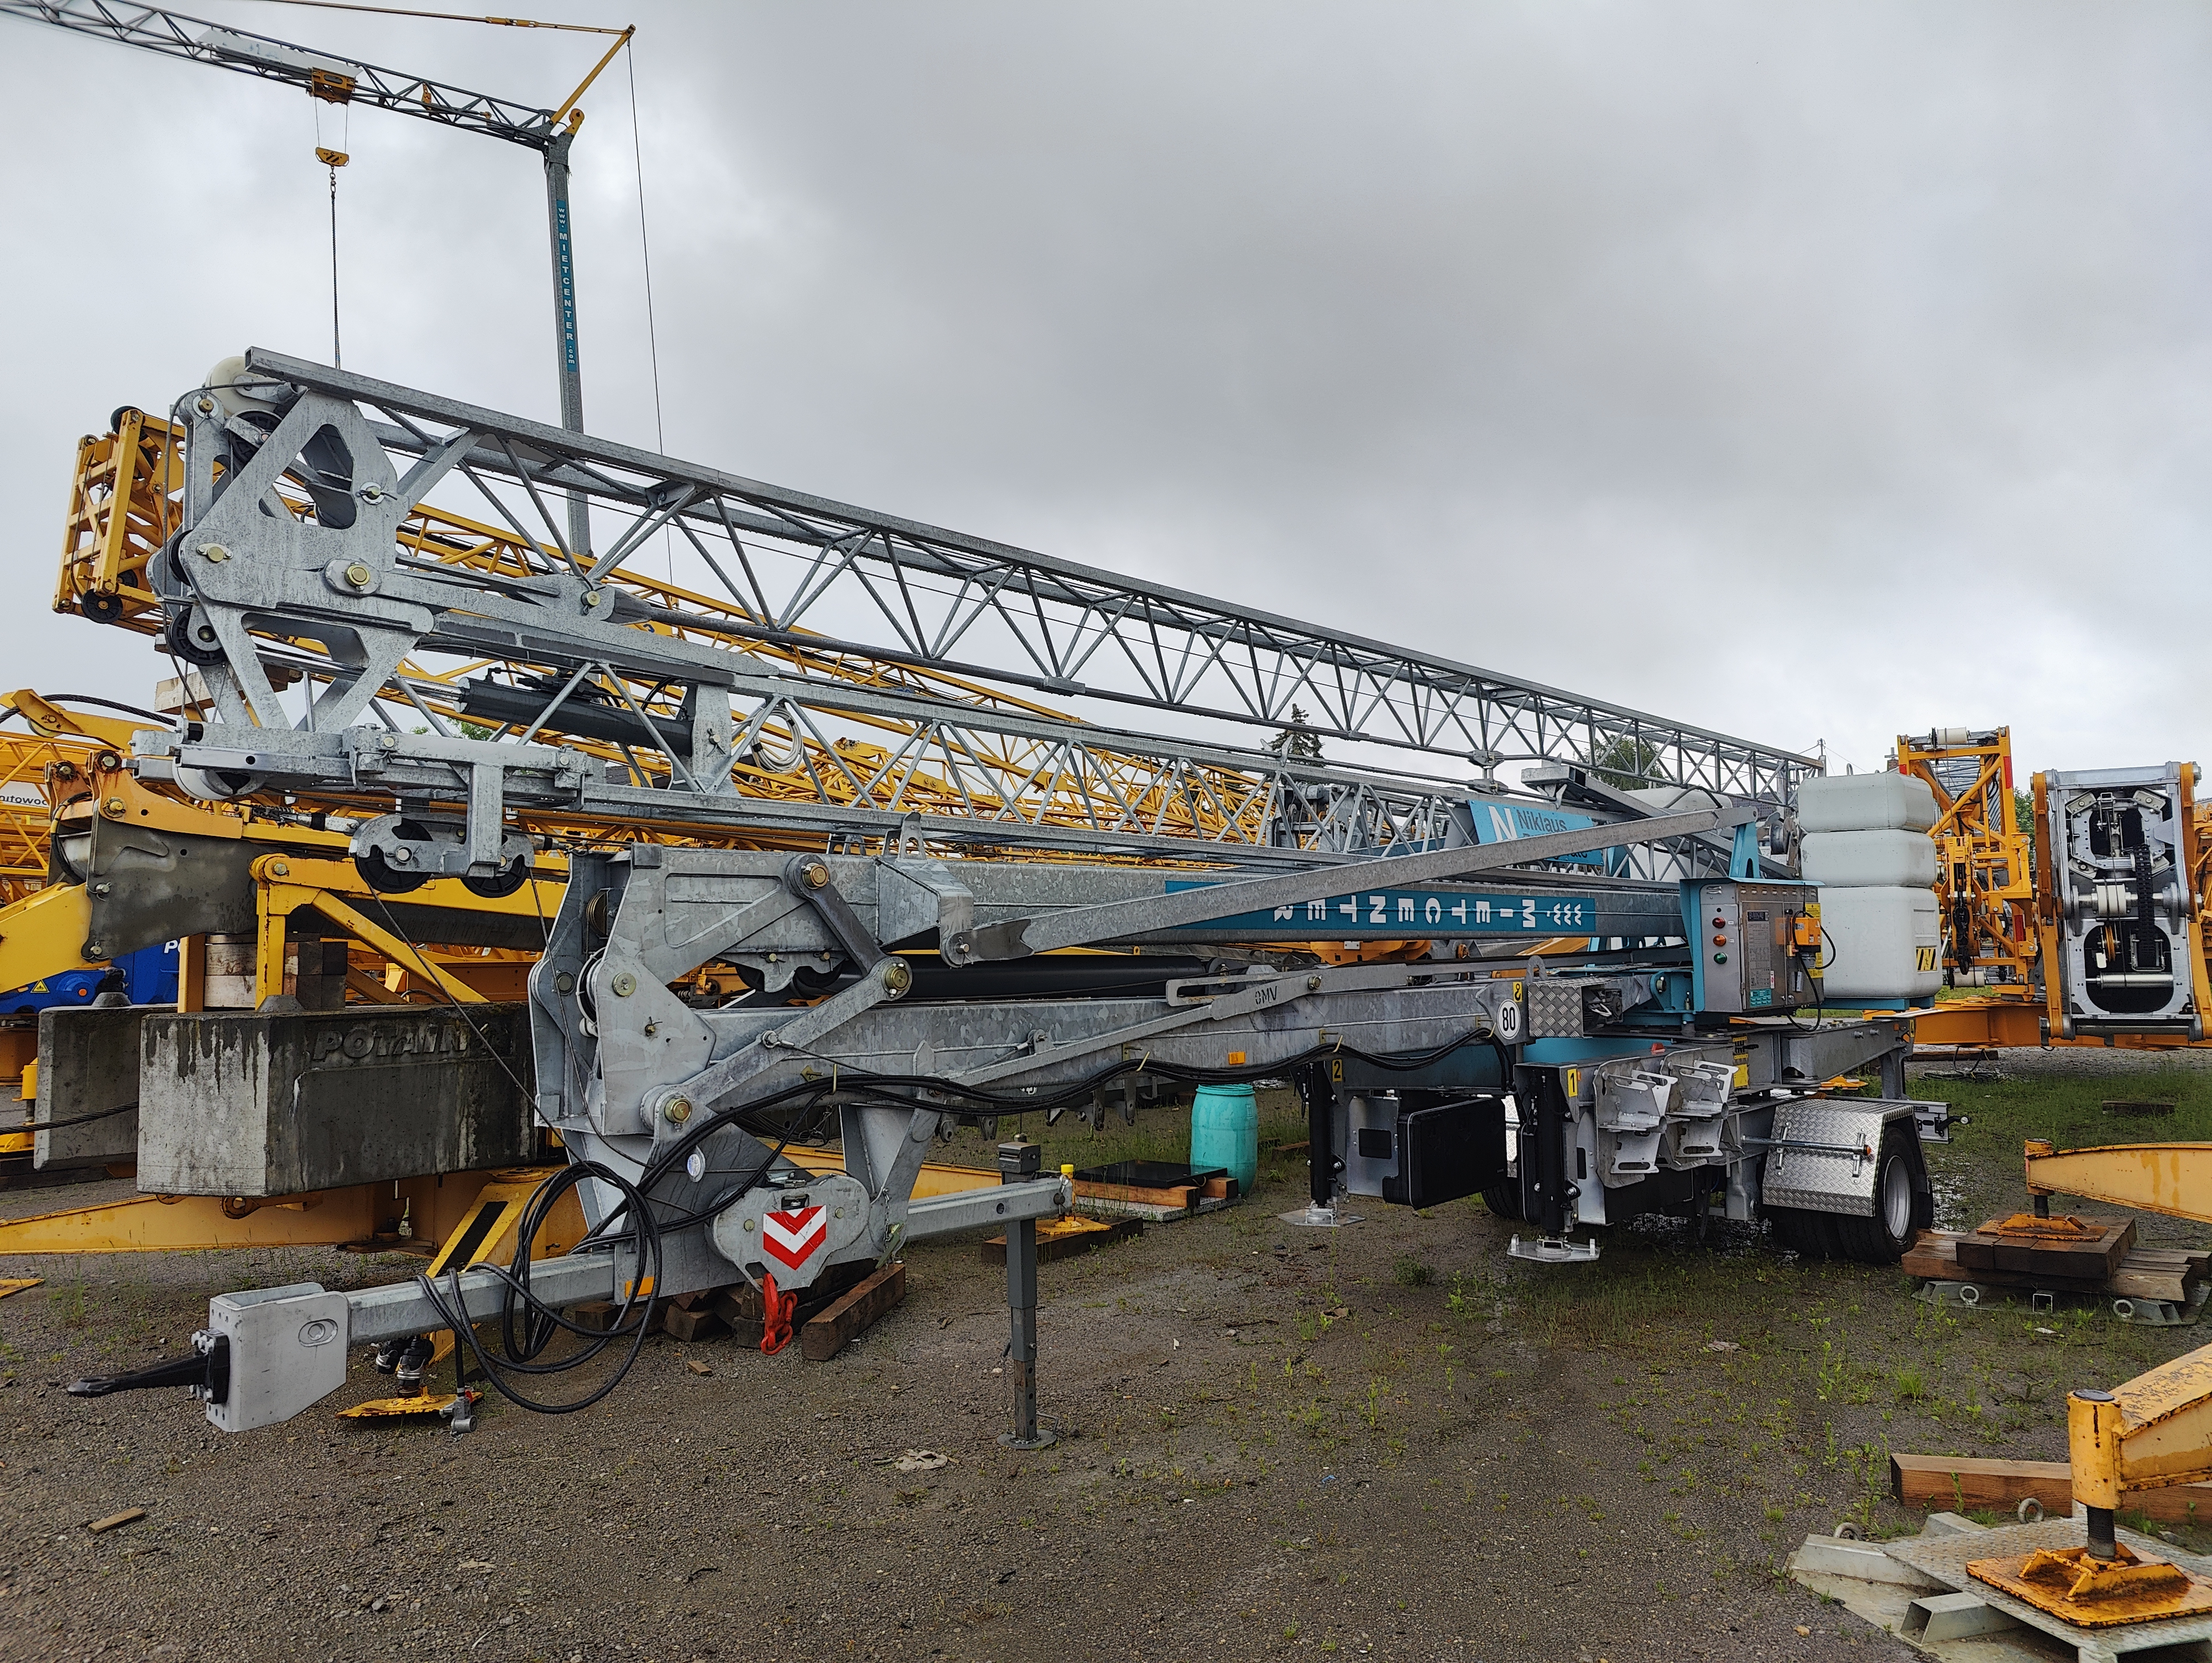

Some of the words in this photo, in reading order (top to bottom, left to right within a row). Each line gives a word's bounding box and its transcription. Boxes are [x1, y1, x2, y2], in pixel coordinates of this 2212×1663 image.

[1516, 809, 1567, 833] Niklaus
[1502, 1006, 1516, 1032] 80
[313, 1023, 470, 1060] POTAIN
[1334, 1060, 1341, 1079] 2
[1570, 1072, 1575, 1093] 1
